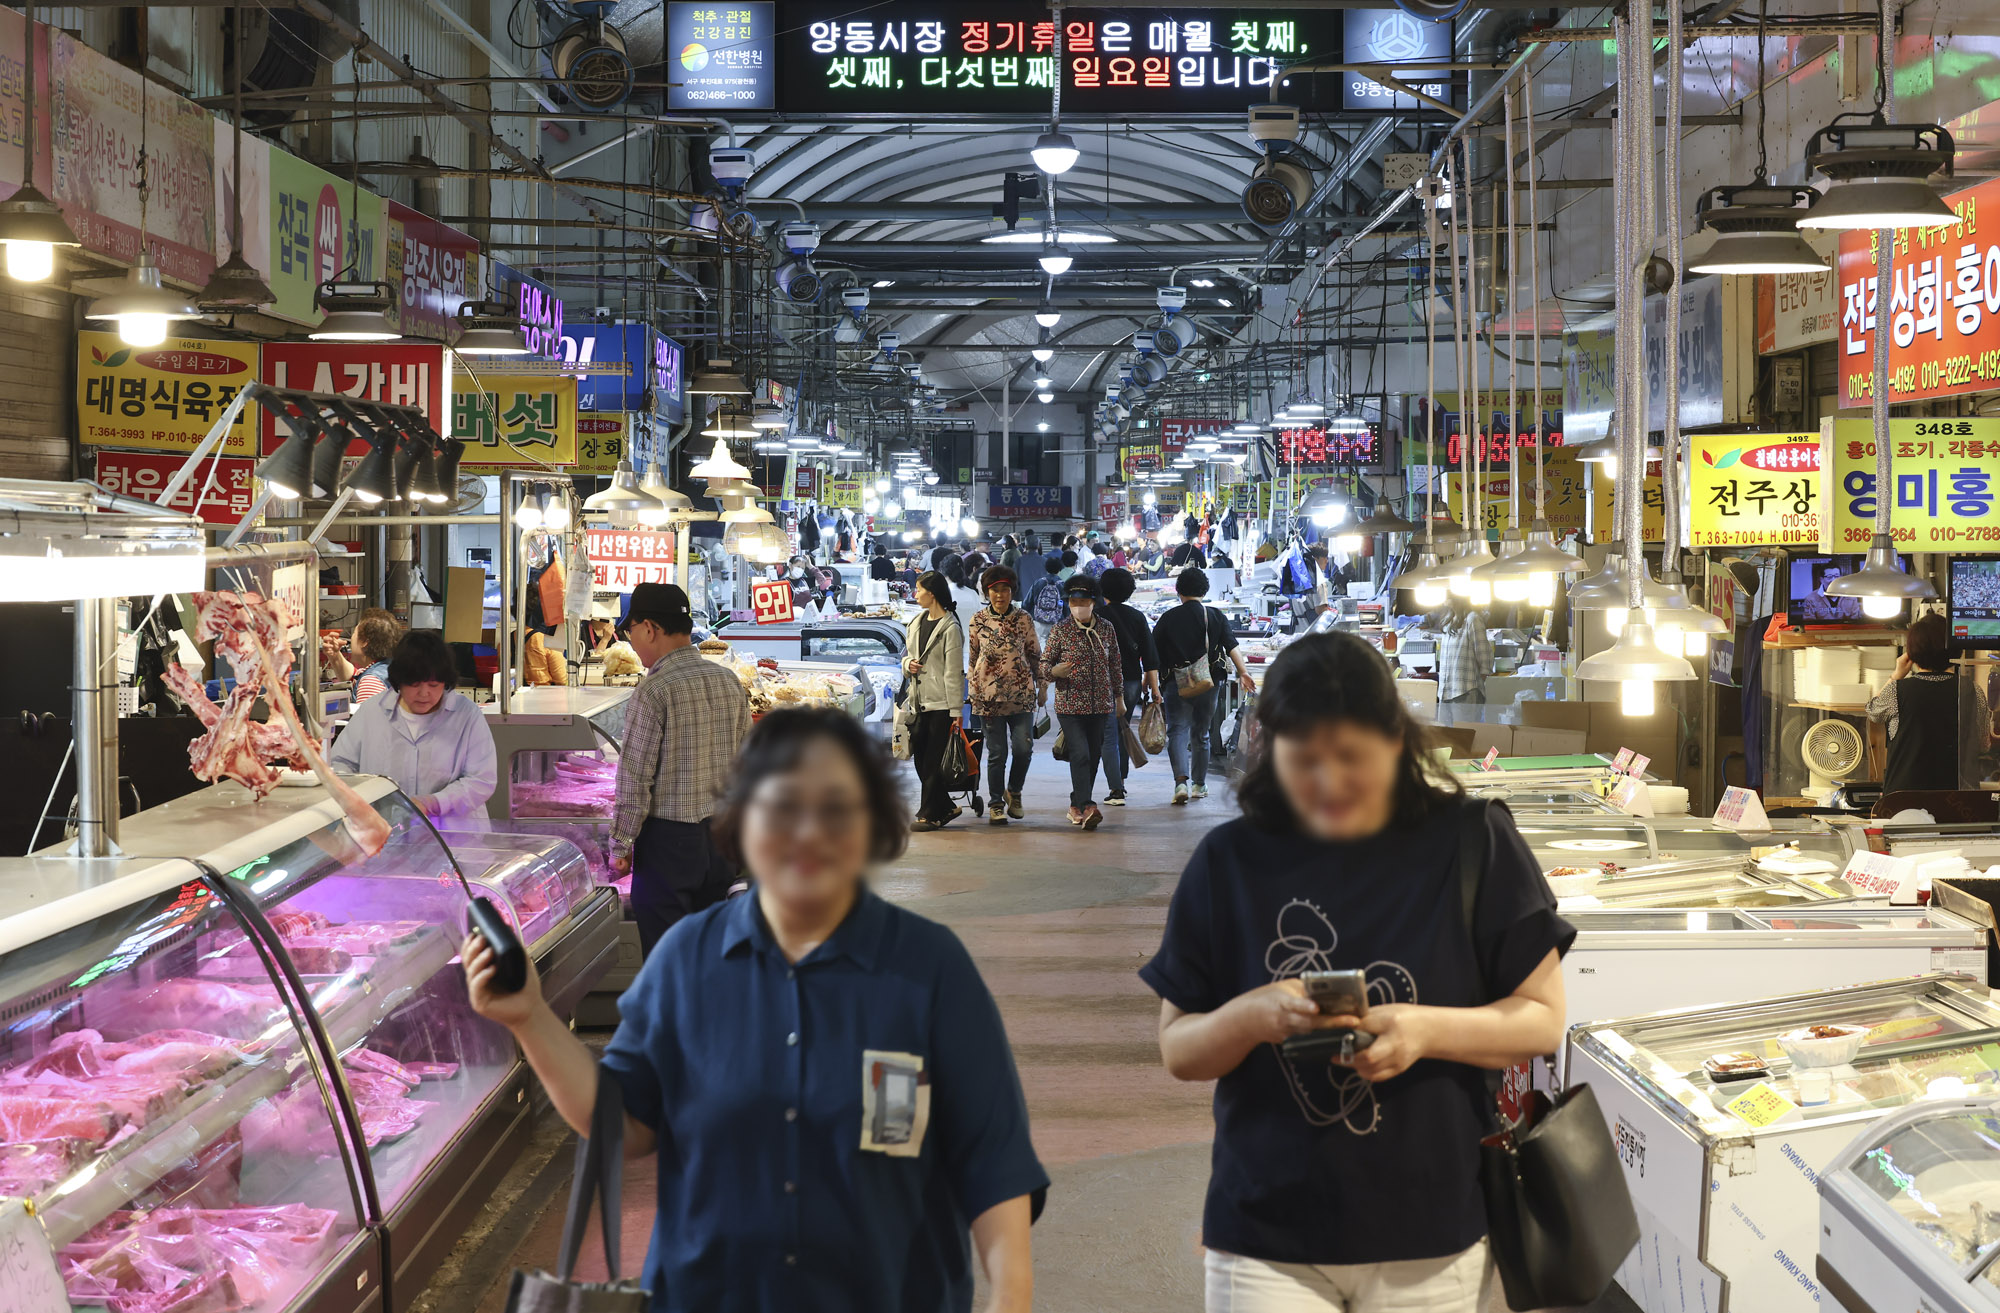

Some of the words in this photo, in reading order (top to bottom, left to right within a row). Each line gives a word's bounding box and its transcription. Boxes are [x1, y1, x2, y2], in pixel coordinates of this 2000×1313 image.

[692, 10, 752, 24] 척추·관절
[809, 22, 946, 53] 양동시장
[960, 21, 1132, 53] 정기휴일은
[1148, 21, 1213, 53] 매월
[1230, 21, 1309, 55] 첫째,
[712, 50, 763, 65] 선한병원
[826, 57, 904, 89] 셋째,
[920, 57, 1056, 89] 다섯번째
[687, 90, 756, 100] 062)466-1000
[278, 191, 310, 282] 잡곡
[154, 353, 231, 374] 수입쇠고기
[1848, 364, 1916, 400] 010-3-4192
[1921, 350, 2000, 390] 010-3222-4192
[85, 375, 246, 425] 대명식육점
[451, 391, 559, 449] 버섯
[1915, 422, 1974, 436] 348호
[88, 425, 145, 440] T.364-3993
[151, 430, 245, 447] HP.010-86-695
[1001, 488, 1062, 504] 동영상회
[1708, 479, 1817, 516] 전주상
[1694, 530, 1764, 545] T.363-7004
[1843, 527, 1917, 543] 366-264
[594, 564, 668, 587] 돼지고기
[754, 583, 793, 623] 오리
[1780, 1142, 1808, 1171] KWANG
[1773, 1249, 1802, 1278] KWANG
